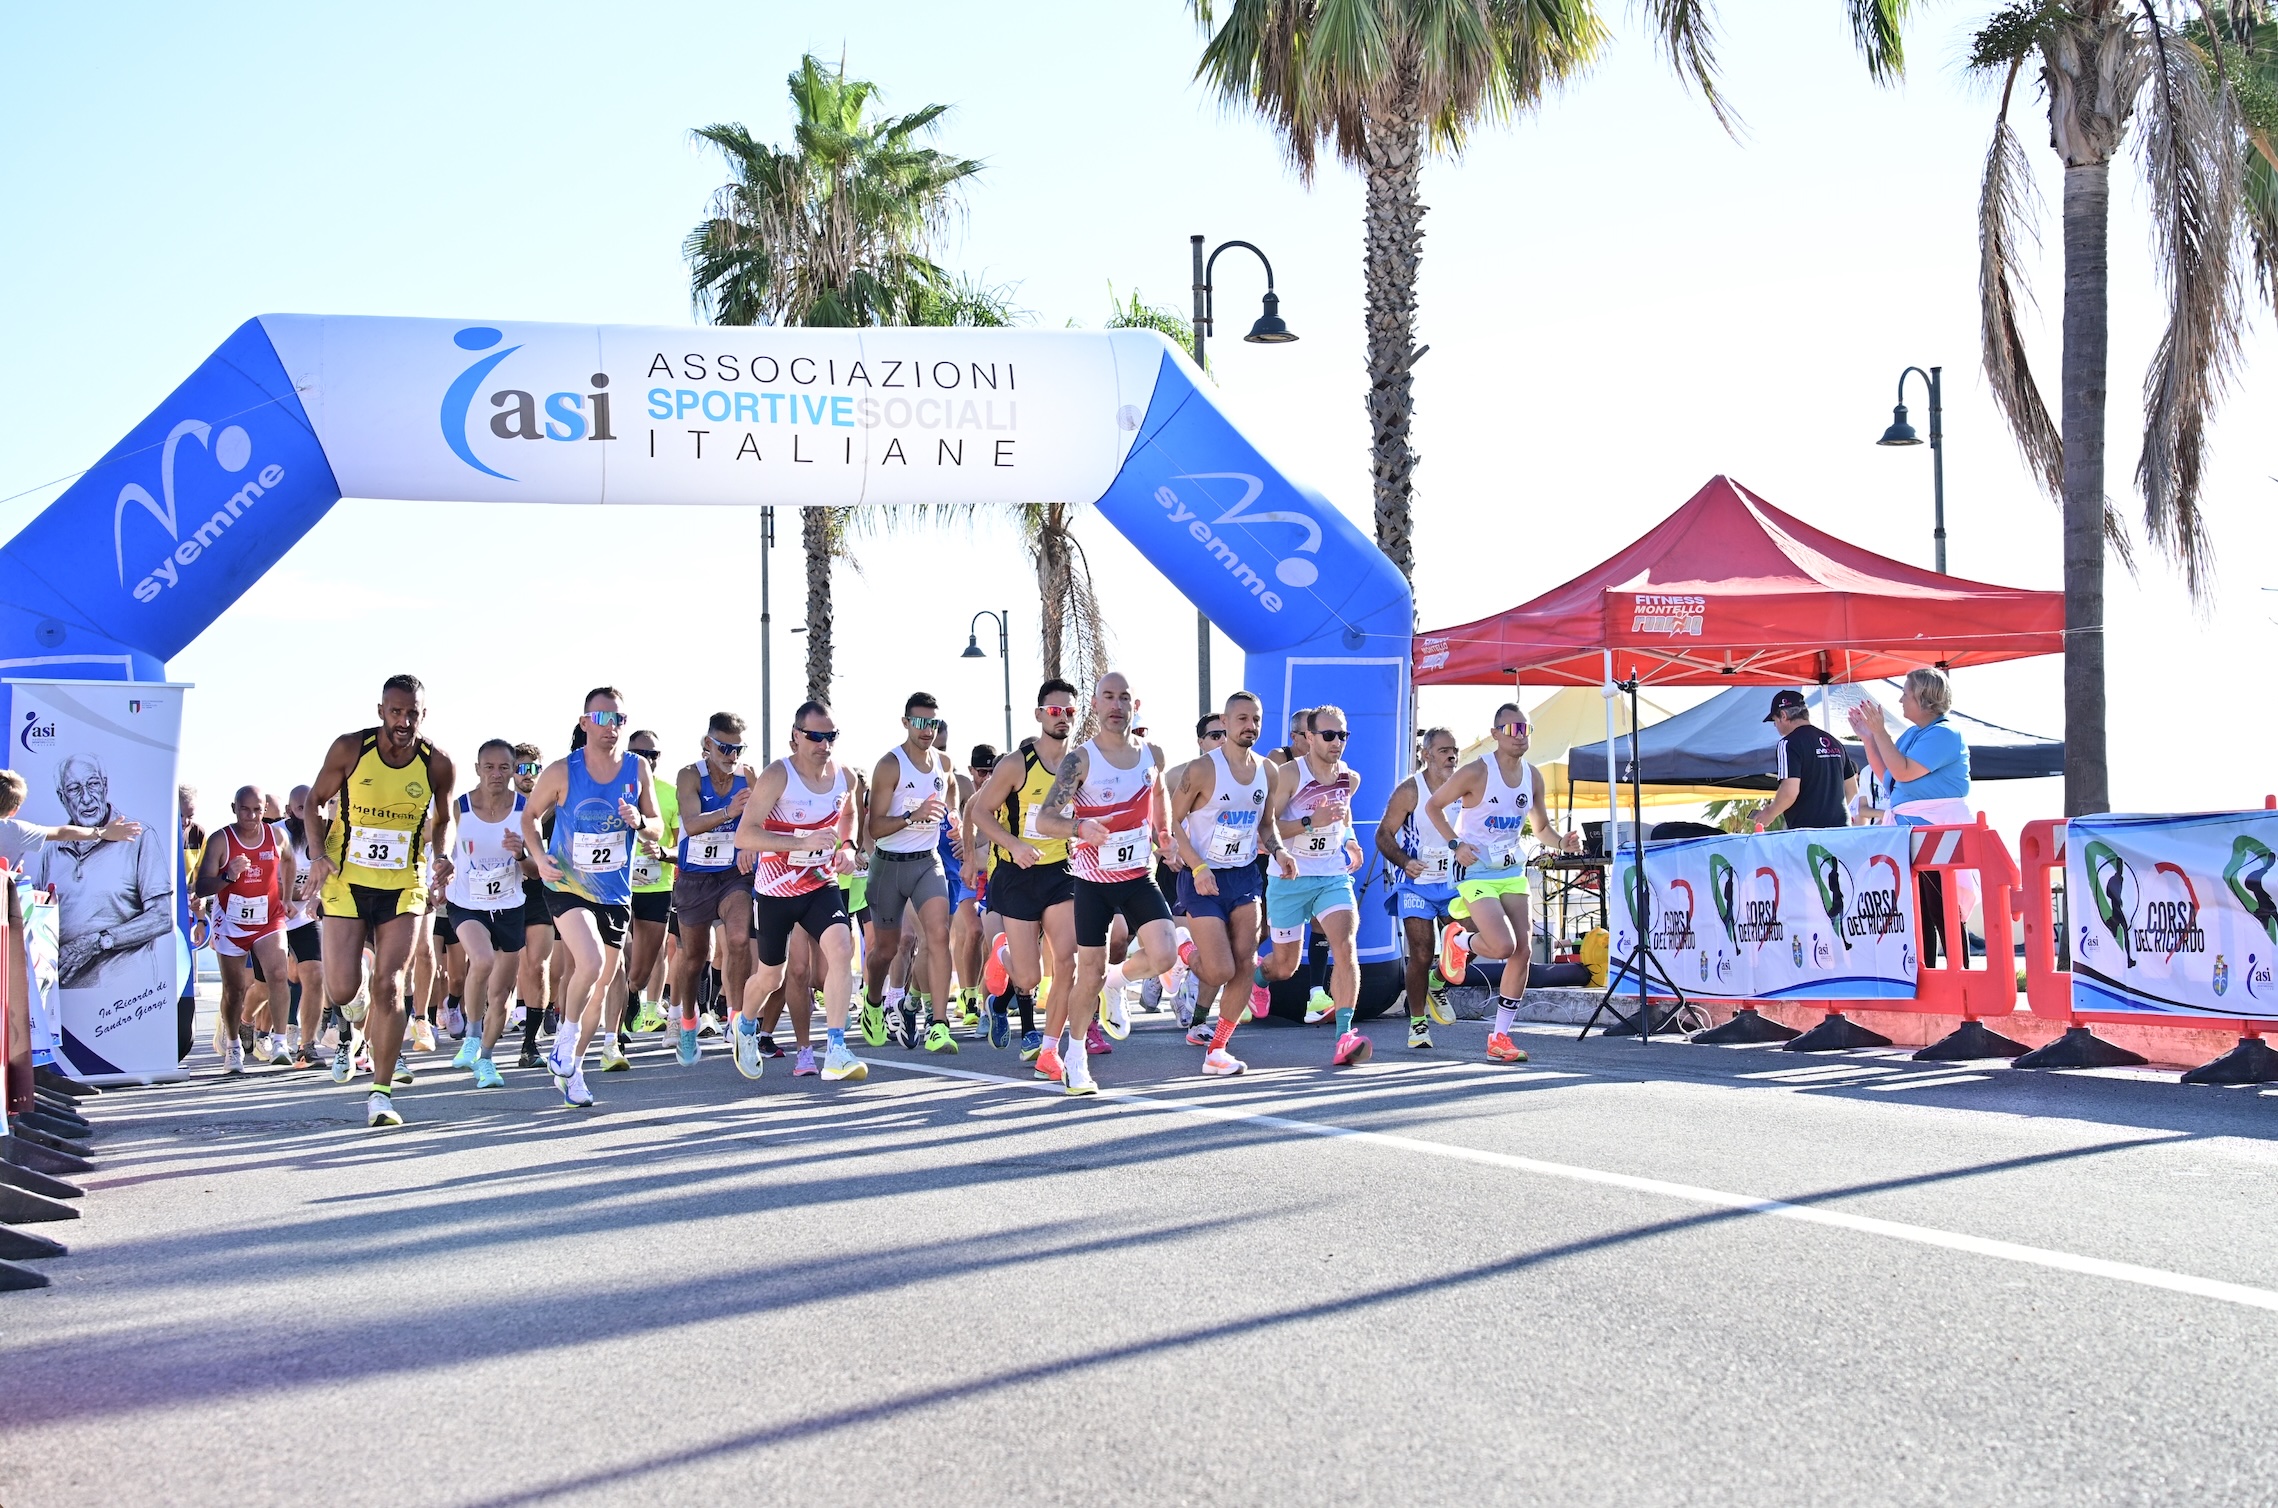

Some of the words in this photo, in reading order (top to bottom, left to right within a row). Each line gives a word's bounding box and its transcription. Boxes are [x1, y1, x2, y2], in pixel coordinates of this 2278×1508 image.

[647, 352, 1015, 391] ASSOCIAZIONI
[490, 372, 617, 442] asi
[650, 429, 1016, 467] ITALIANE
[132, 463, 285, 603] syemme
[1153, 485, 1284, 613] syemme
[1635, 594, 1706, 605] FITNESS
[1634, 604, 1706, 614] MONTELLO
[32, 722, 55, 738] asi
[1217, 811, 1257, 825] AVIS
[1484, 815, 1522, 830] AVIS
[368, 844, 389, 860] 33
[704, 845, 718, 858] 91
[1309, 837, 1326, 851] 36
[592, 848, 611, 864] 22
[1117, 845, 1135, 862] 97
[486, 881, 501, 895] 12
[1403, 899, 1426, 910] ROCCO
[1857, 889, 1898, 920] CORSA
[241, 908, 254, 919] 51
[2147, 900, 2198, 934] CORSA
[1664, 910, 1692, 936] CORSA
[1847, 915, 1867, 936] DEL
[1868, 912, 1905, 936] RICORDO
[1653, 932, 1667, 950] DEL
[2087, 936, 2099, 947] asi
[2133, 929, 2153, 953] DEL
[2154, 928, 2205, 953] RICORDO
[1818, 943, 1829, 955] asi
[2255, 967, 2272, 982] asi
[113, 990, 154, 1013] Ricordo
[156, 981, 168, 992] di
[94, 1015, 133, 1038] Sandro
[135, 997, 168, 1020] Giorgi
